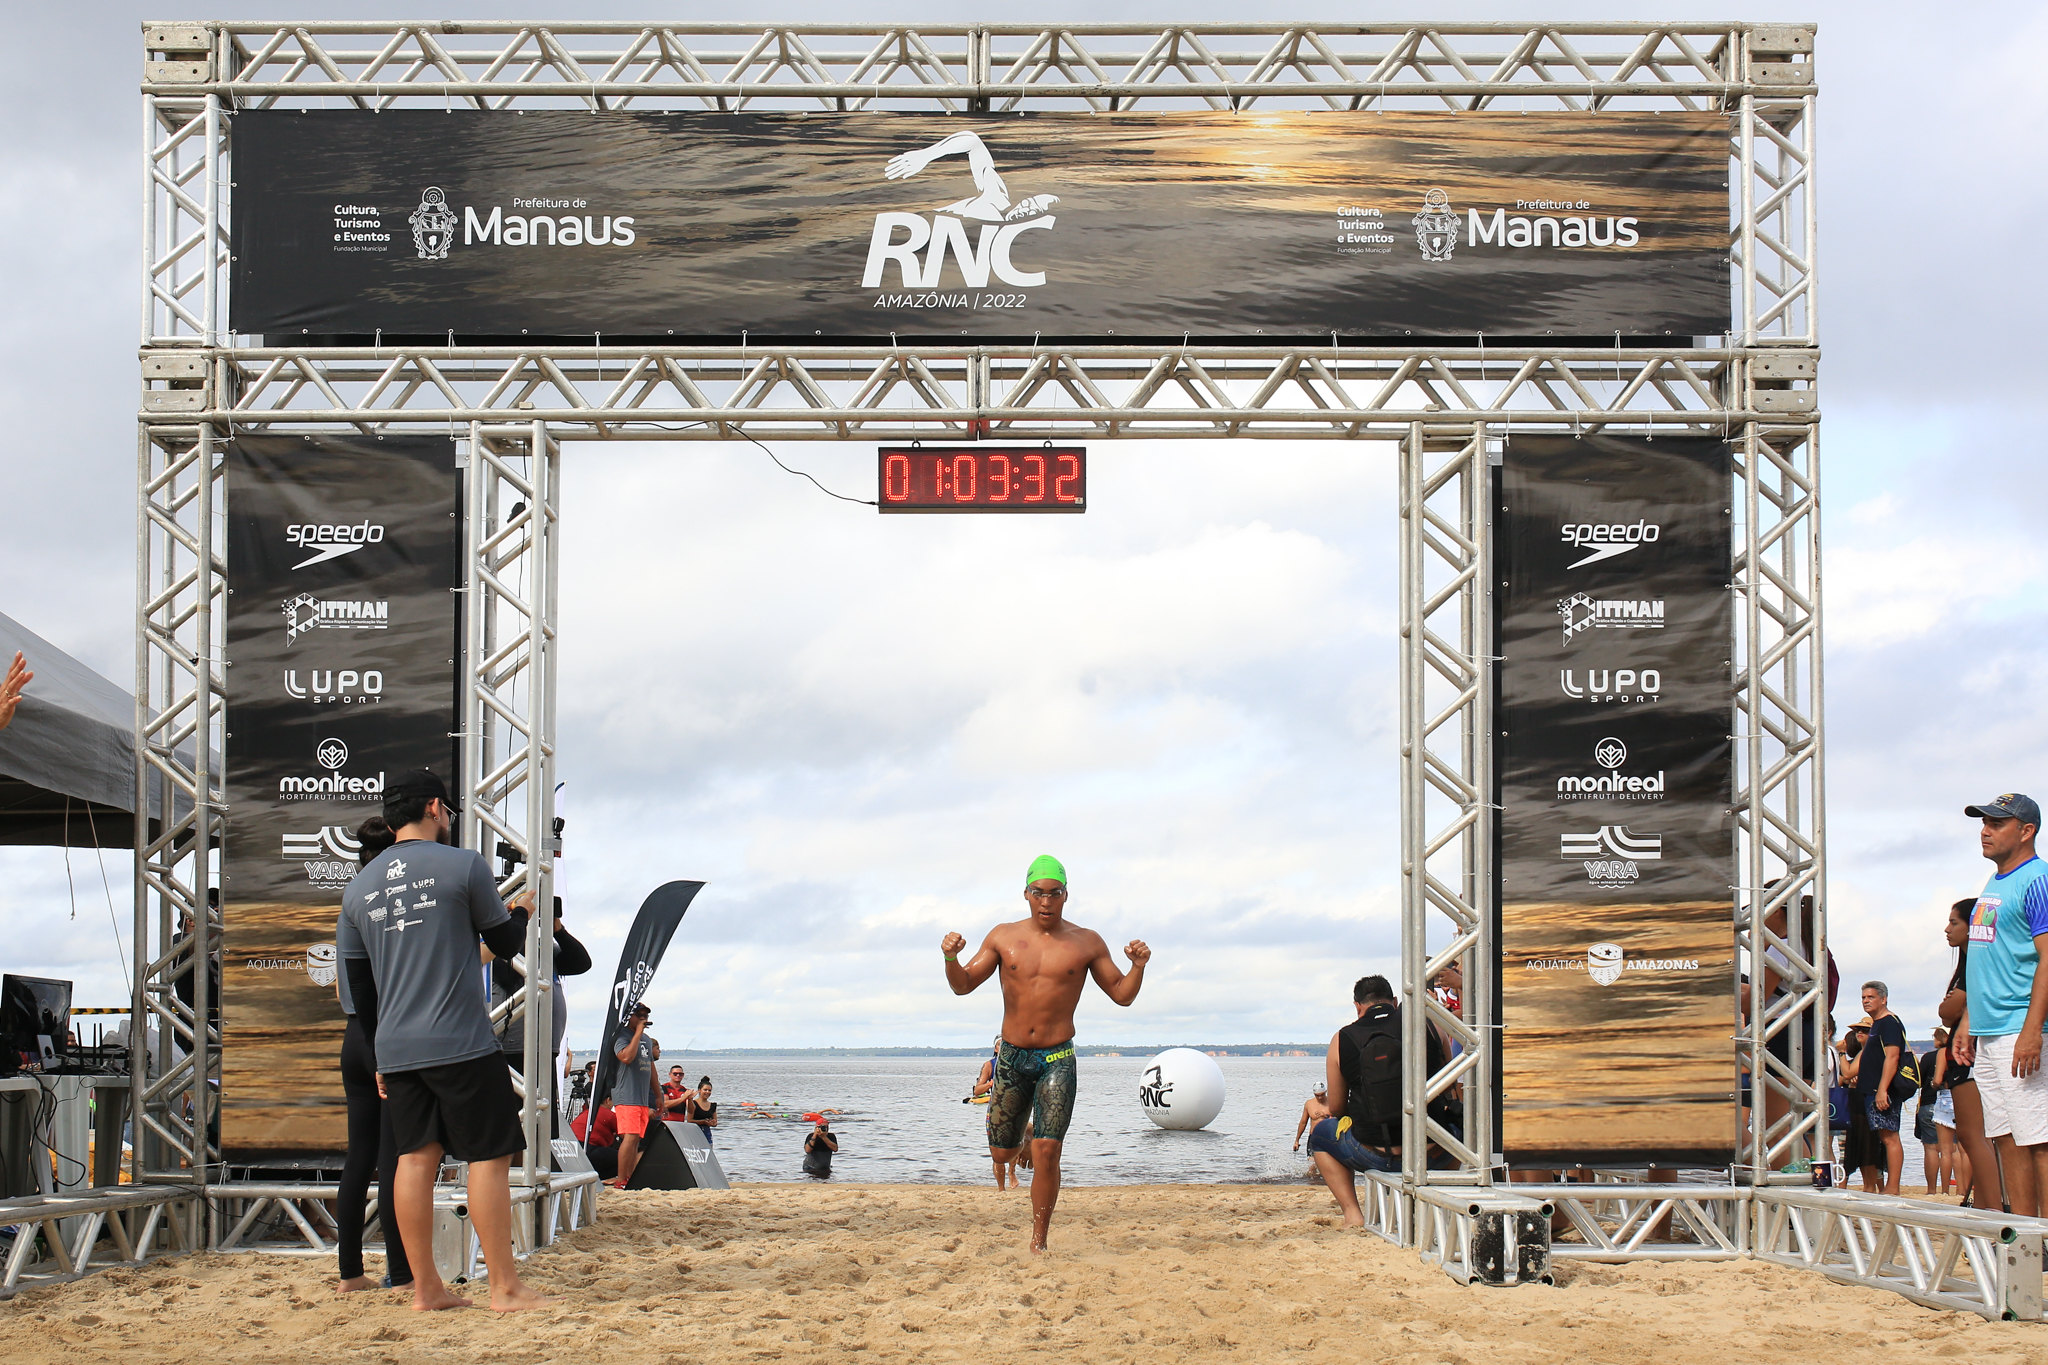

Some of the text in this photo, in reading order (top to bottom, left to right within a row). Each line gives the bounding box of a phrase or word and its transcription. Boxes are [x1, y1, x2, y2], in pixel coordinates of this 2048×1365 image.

[513, 197, 587, 209] Prefeitura de
[1516, 199, 1590, 210] Prefeitura de
[334, 204, 380, 217] Cultura,
[1337, 206, 1383, 219] Cultura,
[334, 218, 381, 229] Turismo
[464, 205, 636, 247] Manaus
[1337, 219, 1384, 230] Turismo
[1468, 207, 1639, 248] Manaus
[334, 231, 391, 242] e Eventos
[1337, 233, 1394, 244] e Eventos
[333, 245, 388, 254] Fundação Municipal
[861, 212, 1057, 288] RNC
[1337, 247, 1392, 255] Fundação Municipal
[873, 291, 969, 308] AMAZÔNIA
[982, 293, 1027, 308] 2022
[286, 520, 385, 547] speedo
[1561, 519, 1660, 547] speedo
[284, 670, 383, 699] LUPO
[1561, 669, 1660, 698] LUPO
[313, 696, 382, 704] SPORT
[1590, 695, 1660, 703] SPORT
[280, 771, 385, 793] montreal
[1557, 770, 1665, 792] montreal
[279, 793, 336, 801] HORTIFRUTI
[304, 861, 358, 880] YARA
[1583, 861, 1640, 879] YARA
[246, 957, 303, 970] AQUÁTICA
[1526, 957, 1699, 970] AQUÁTICA AMAZONAS
[1140, 1085, 1173, 1108] RNC
